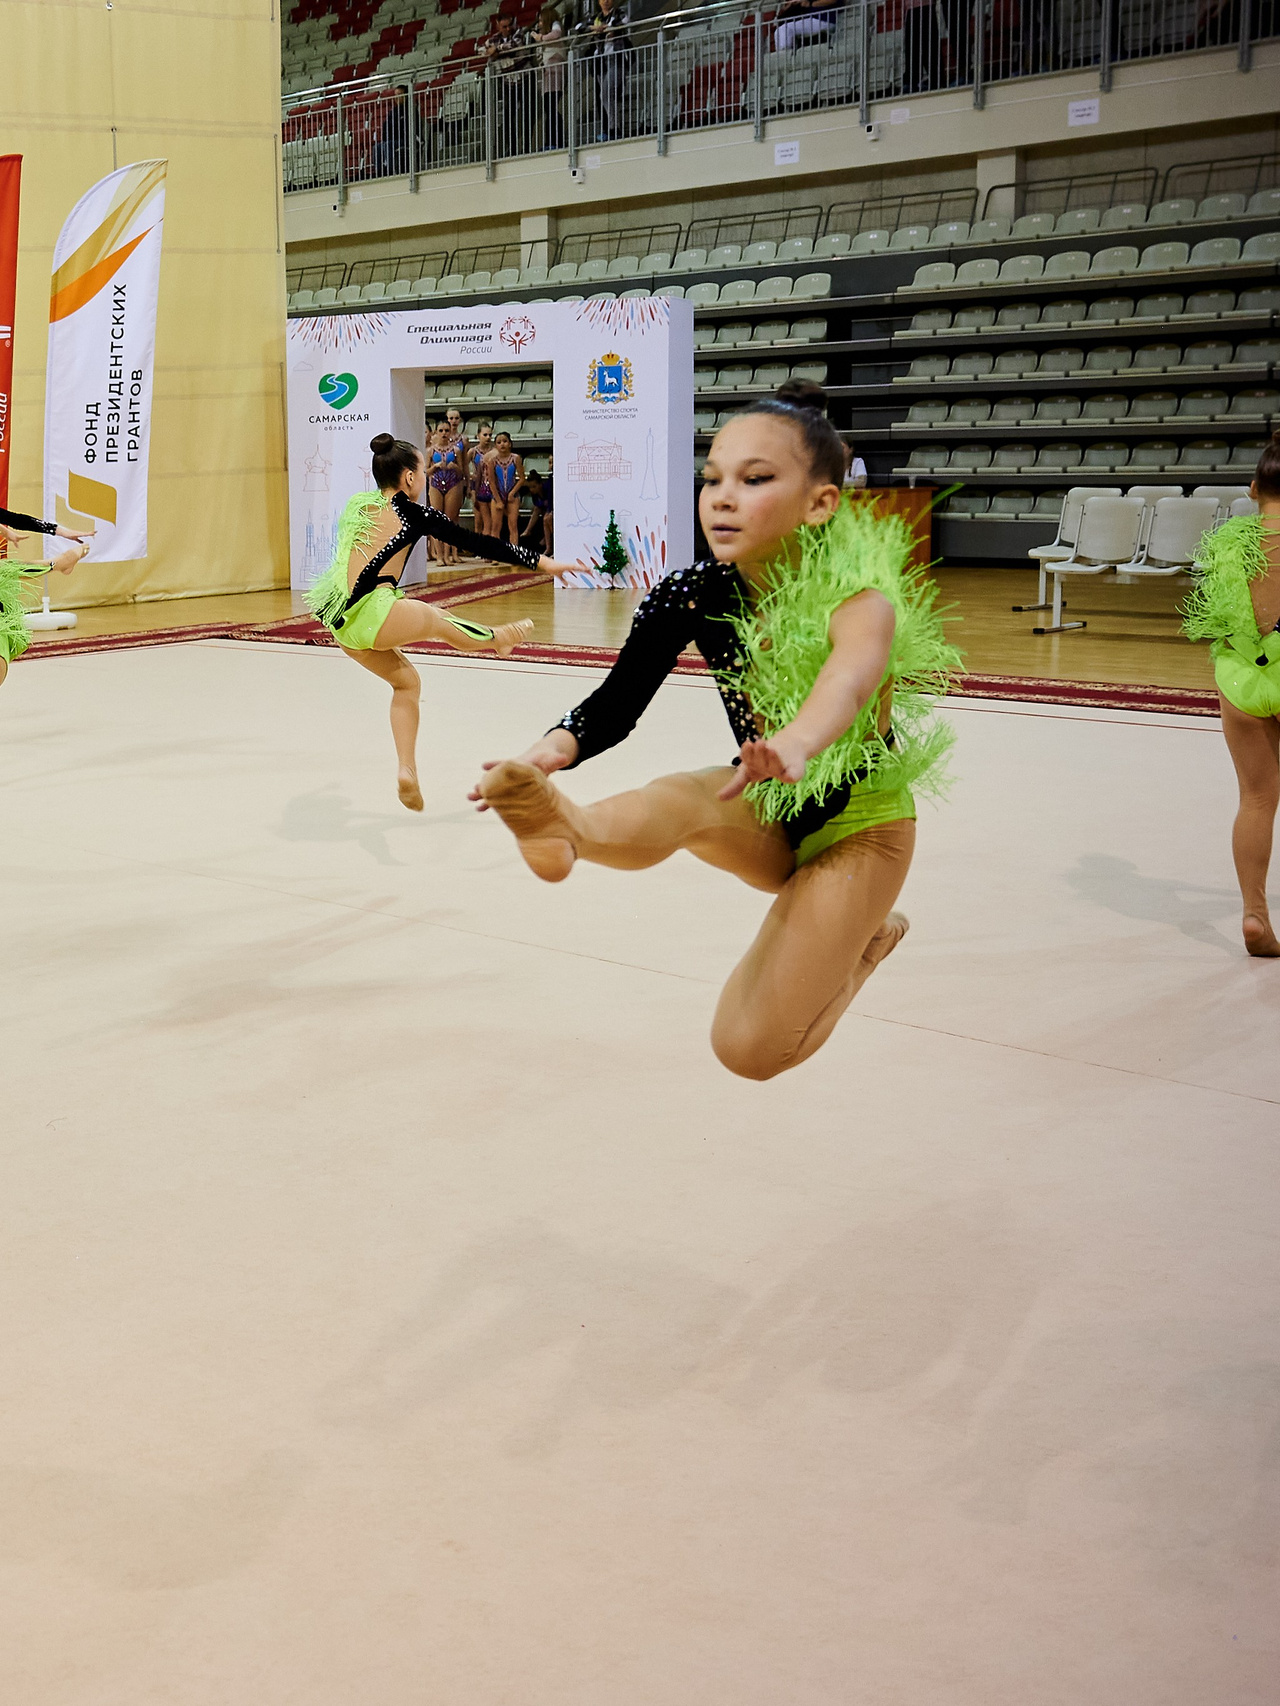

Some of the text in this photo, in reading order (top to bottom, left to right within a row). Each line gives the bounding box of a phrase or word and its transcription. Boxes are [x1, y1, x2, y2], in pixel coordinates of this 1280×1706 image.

[407, 322, 492, 334] Специальная
[420, 334, 493, 345] Олимпиада
[460, 346, 493, 354] России
[106, 284, 127, 463] ПРЕЗИДЕНТСКИХ
[128, 369, 143, 462] ГРАНТОВ
[308, 413, 370, 424] САМАРСКАЯ
[84, 402, 101, 463] ФОНД
